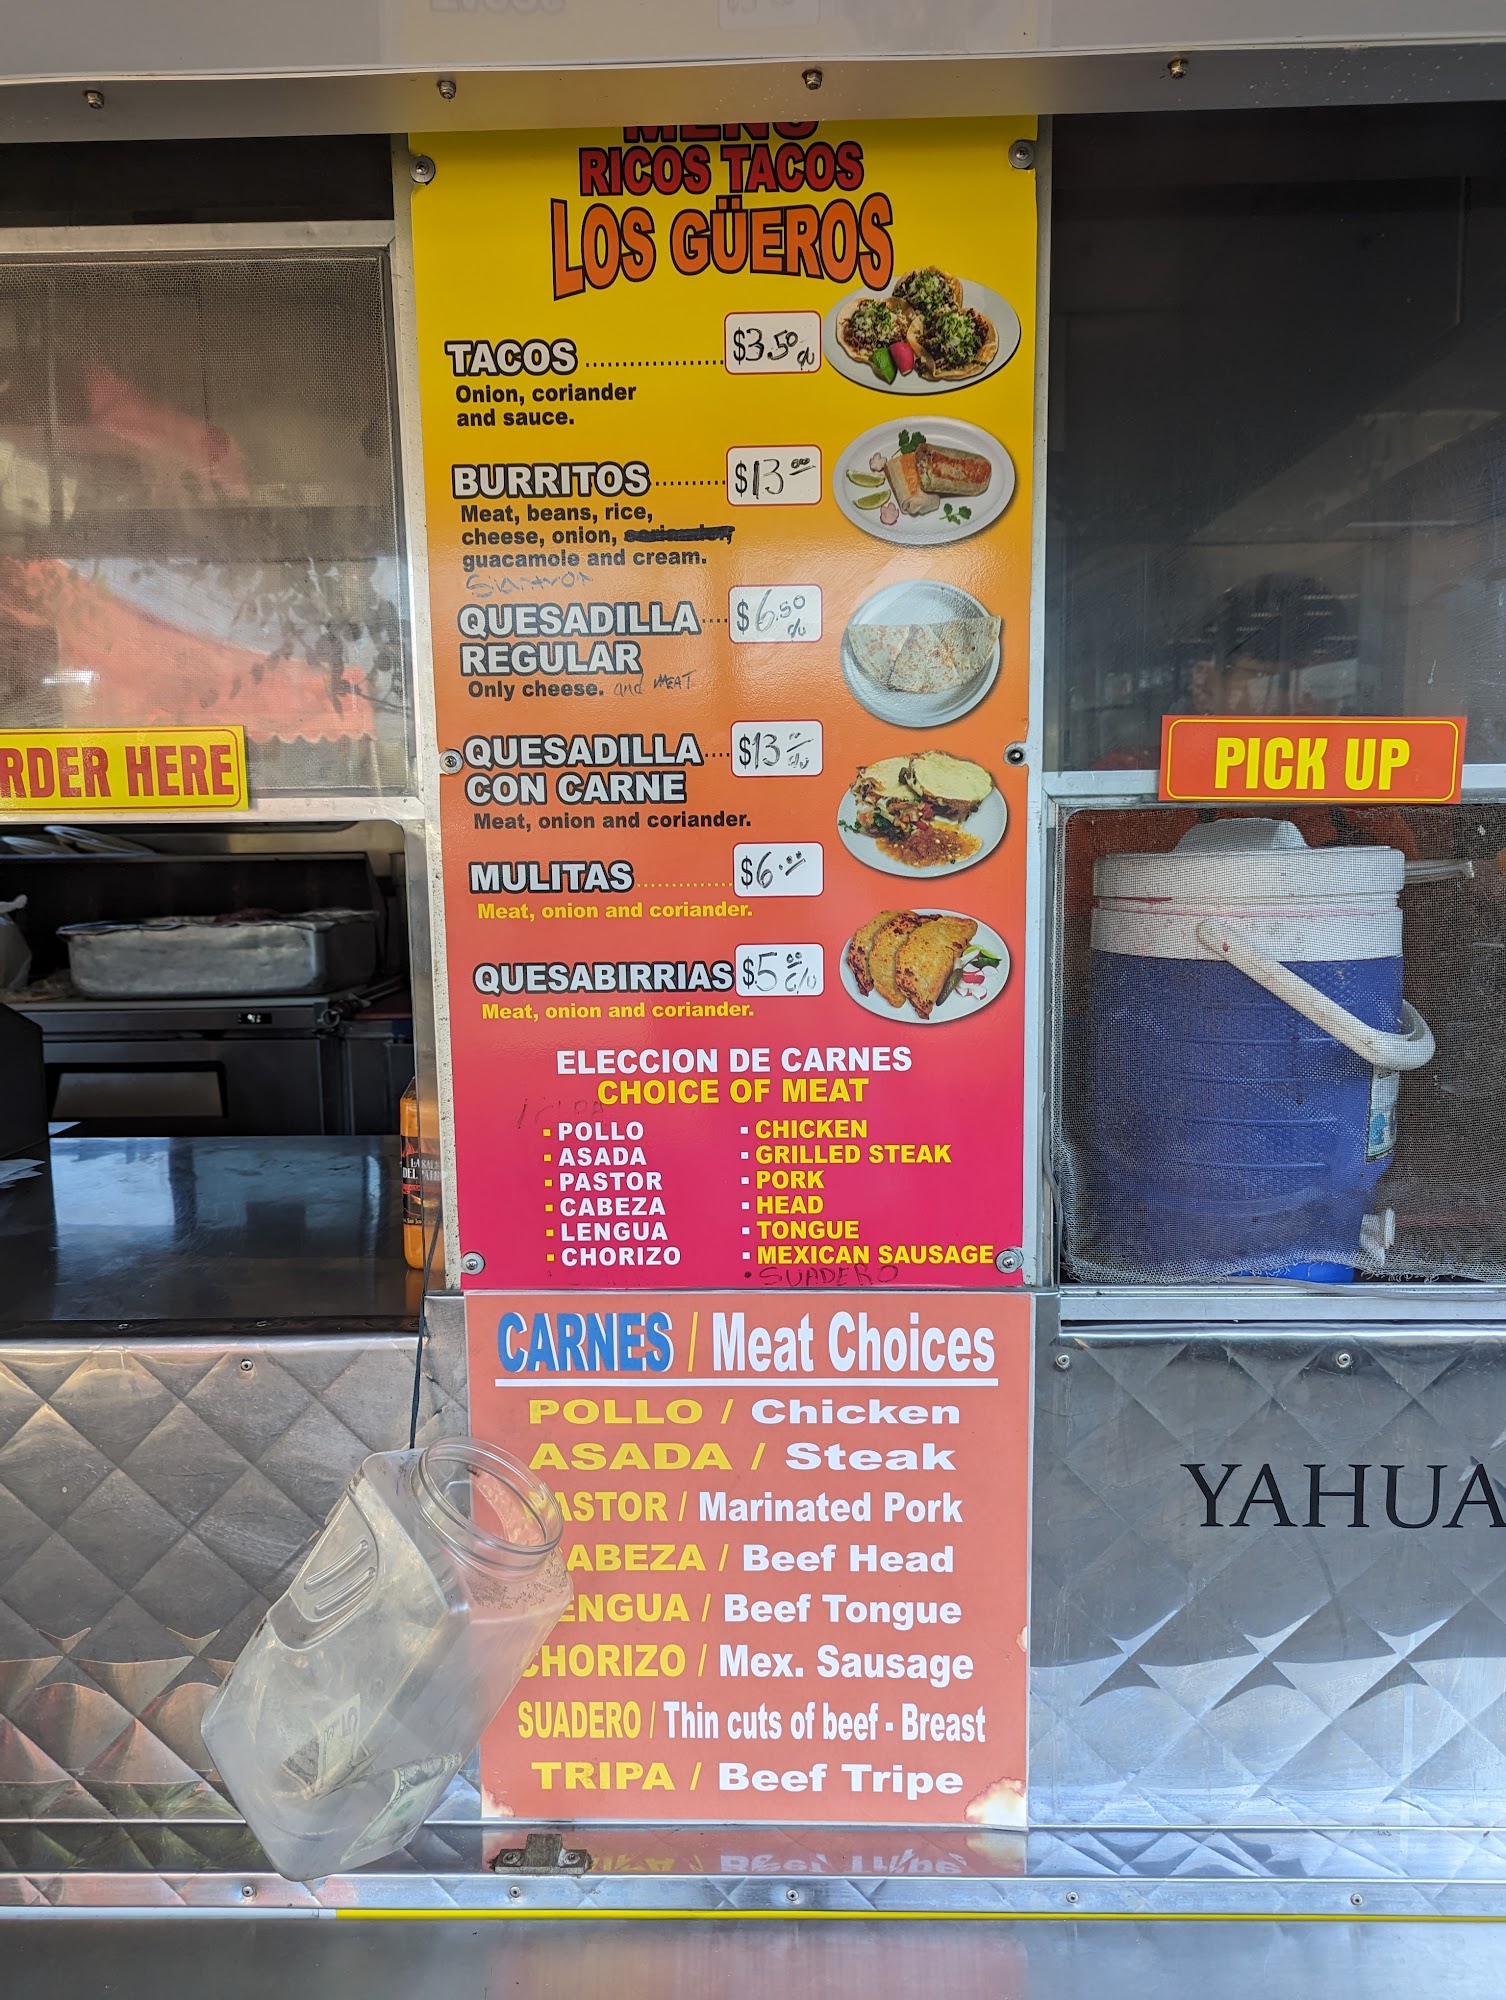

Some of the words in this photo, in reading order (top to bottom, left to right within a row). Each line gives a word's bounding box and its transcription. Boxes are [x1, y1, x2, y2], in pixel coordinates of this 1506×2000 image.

[579, 145, 712, 197] RICOS
[720, 141, 865, 194] TACOS
[551, 198, 656, 301] LOS
[670, 192, 894, 291] GÜEROS
[445, 338, 578, 376] TACOS
[455, 385, 525, 406] Onion,
[532, 382, 637, 402] coriander
[457, 408, 496, 427] and
[503, 410, 575, 426] sauce.
[452, 461, 651, 499] BURRITOS
[460, 505, 520, 525] Meat,
[527, 504, 598, 524] beans,
[605, 503, 653, 522] rice,
[462, 528, 545, 547] cheese,
[552, 527, 617, 546] onion,
[463, 550, 579, 573] guacamole
[587, 549, 625, 566] and
[633, 550, 707, 566] cream.
[458, 601, 702, 640] QUESADILLA
[460, 640, 643, 677] REGULAR
[468, 681, 515, 701] Only
[522, 681, 604, 697] cheese.
[613, 674, 645, 698] and
[463, 733, 704, 770] QUESADILLA
[1214, 737, 1328, 790] PICK
[1344, 738, 1411, 791] UP
[0, 747, 111, 798] RDER
[126, 744, 235, 798] HERE
[465, 771, 550, 805] CON
[555, 771, 687, 804] CARNE
[474, 813, 531, 832] Meat,
[538, 813, 595, 829] onion
[602, 812, 640, 828] and
[647, 810, 751, 828] coriander.
[469, 860, 635, 894] MULITAS
[477, 903, 535, 922] Meat,
[542, 903, 599, 919] onion
[605, 902, 643, 918] and
[649, 901, 753, 918] coriander.
[473, 960, 735, 996] QUESABIRRIAS
[482, 1003, 539, 1022] Meat,
[545, 1003, 602, 1019] onion
[608, 1002, 645, 1018] and
[651, 1001, 754, 1018] coriander.
[556, 1048, 718, 1075] ELECCION
[729, 1048, 771, 1073] DE
[781, 1047, 912, 1072] CARNES
[597, 1079, 720, 1105] CHOICE
[729, 1078, 770, 1103] OF
[782, 1078, 869, 1103] MEAT
[558, 1121, 644, 1141] POLLO
[755, 1119, 867, 1139] CHICKEN
[558, 1147, 647, 1167] ASADA
[755, 1145, 861, 1164] GRILLED
[868, 1144, 952, 1163] STEAK
[559, 1172, 663, 1192] PASTOR
[756, 1170, 825, 1189] PORK
[560, 1197, 666, 1217] CABEZA
[756, 1195, 824, 1214] HEAD
[561, 1222, 668, 1242] LENGUA
[757, 1220, 860, 1239] TONGUE
[561, 1246, 681, 1267] CHORIZO
[757, 1246, 869, 1264] MEXICAN
[878, 1245, 994, 1264] SAUSAGE
[759, 1264, 899, 1287] SUADERO
[498, 1310, 674, 1373] CARNES
[712, 1312, 814, 1373] Meat
[828, 1312, 995, 1373] Choices
[529, 1399, 703, 1425] POLLO
[751, 1399, 960, 1425] Chicken
[529, 1443, 732, 1470] ASADA
[785, 1443, 956, 1471] Steak
[699, 1491, 872, 1523] Marinated
[884, 1492, 963, 1523] Pork
[1180, 1463, 1506, 1529] YAHUA
[558, 1544, 706, 1571] ABEZA
[743, 1544, 837, 1572] Beef
[850, 1545, 954, 1573] Head
[556, 1594, 690, 1622] ENGUA
[724, 1594, 812, 1623] Beef
[822, 1594, 963, 1631] Tongue
[719, 1645, 804, 1678] Mex.
[817, 1645, 974, 1688] Sausage
[518, 1701, 641, 1739] SUADERO
[664, 1701, 719, 1740] Thin
[727, 1703, 782, 1741] cuts
[790, 1702, 816, 1741] of
[823, 1702, 879, 1741] beef
[901, 1704, 986, 1743] Breast
[531, 1762, 675, 1791] TRIPA
[719, 1763, 827, 1792] Beef
[842, 1764, 964, 1800] Tripe
